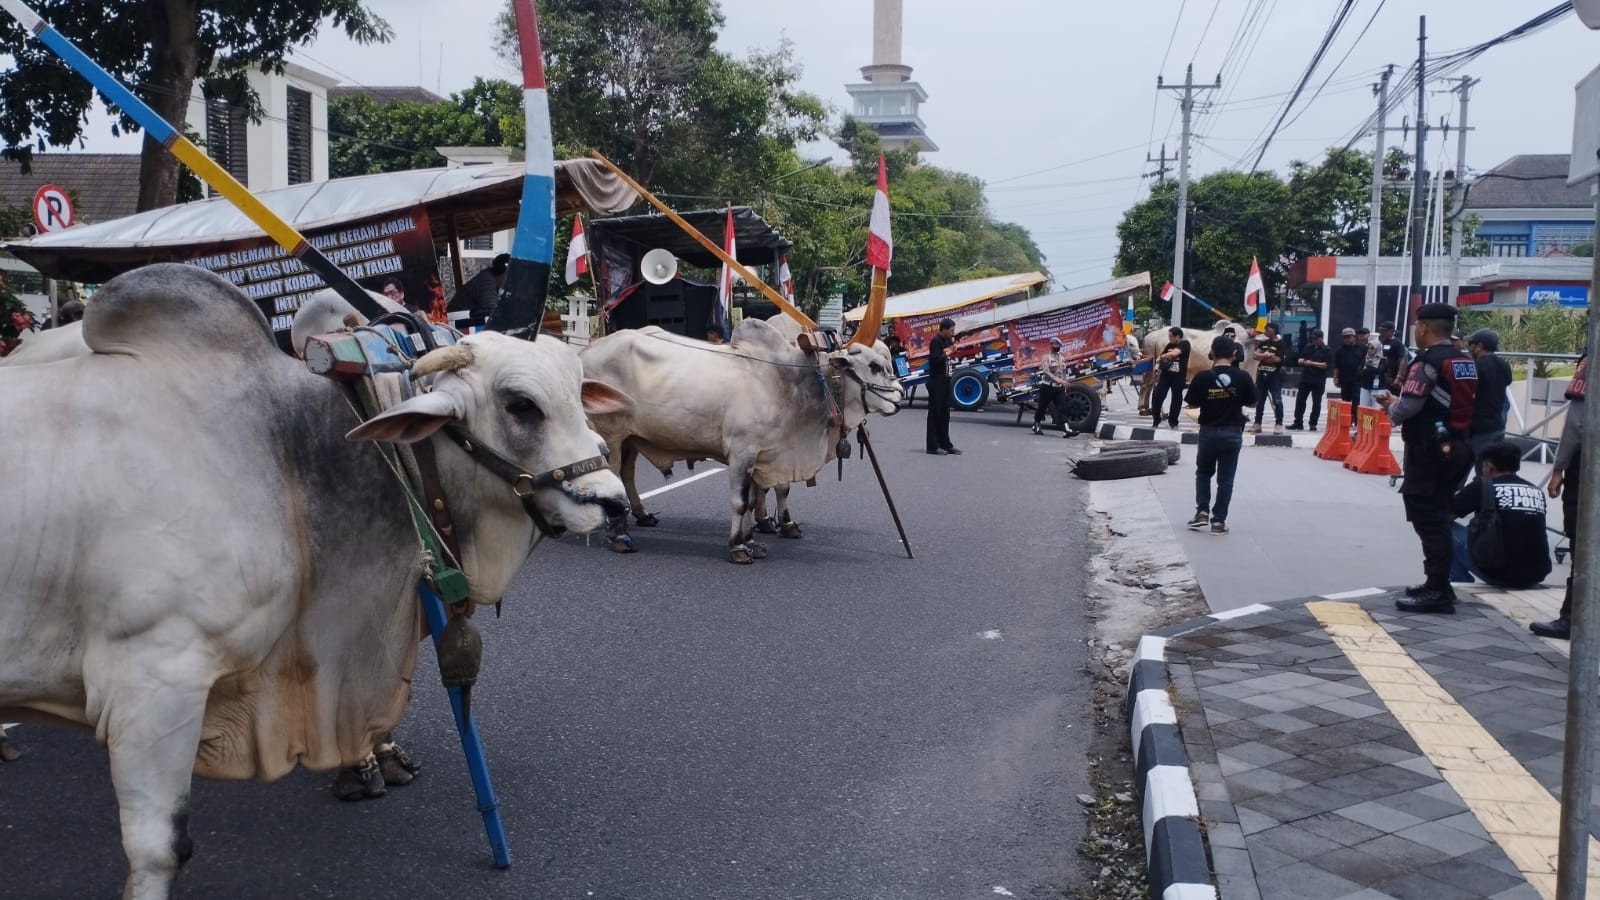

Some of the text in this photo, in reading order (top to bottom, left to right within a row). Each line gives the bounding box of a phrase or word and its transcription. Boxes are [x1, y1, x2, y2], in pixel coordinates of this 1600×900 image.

[230, 246, 272, 266] SLEMAN
[309, 234, 338, 250] IDAK
[340, 224, 379, 245] BERANI
[381, 217, 416, 236] AMBIL
[246, 262, 281, 281] TEGAS
[323, 240, 394, 267] EPENTINGAN
[284, 273, 326, 292] KORBA
[365, 256, 402, 275] TANAH
[275, 296, 298, 313] INTI
